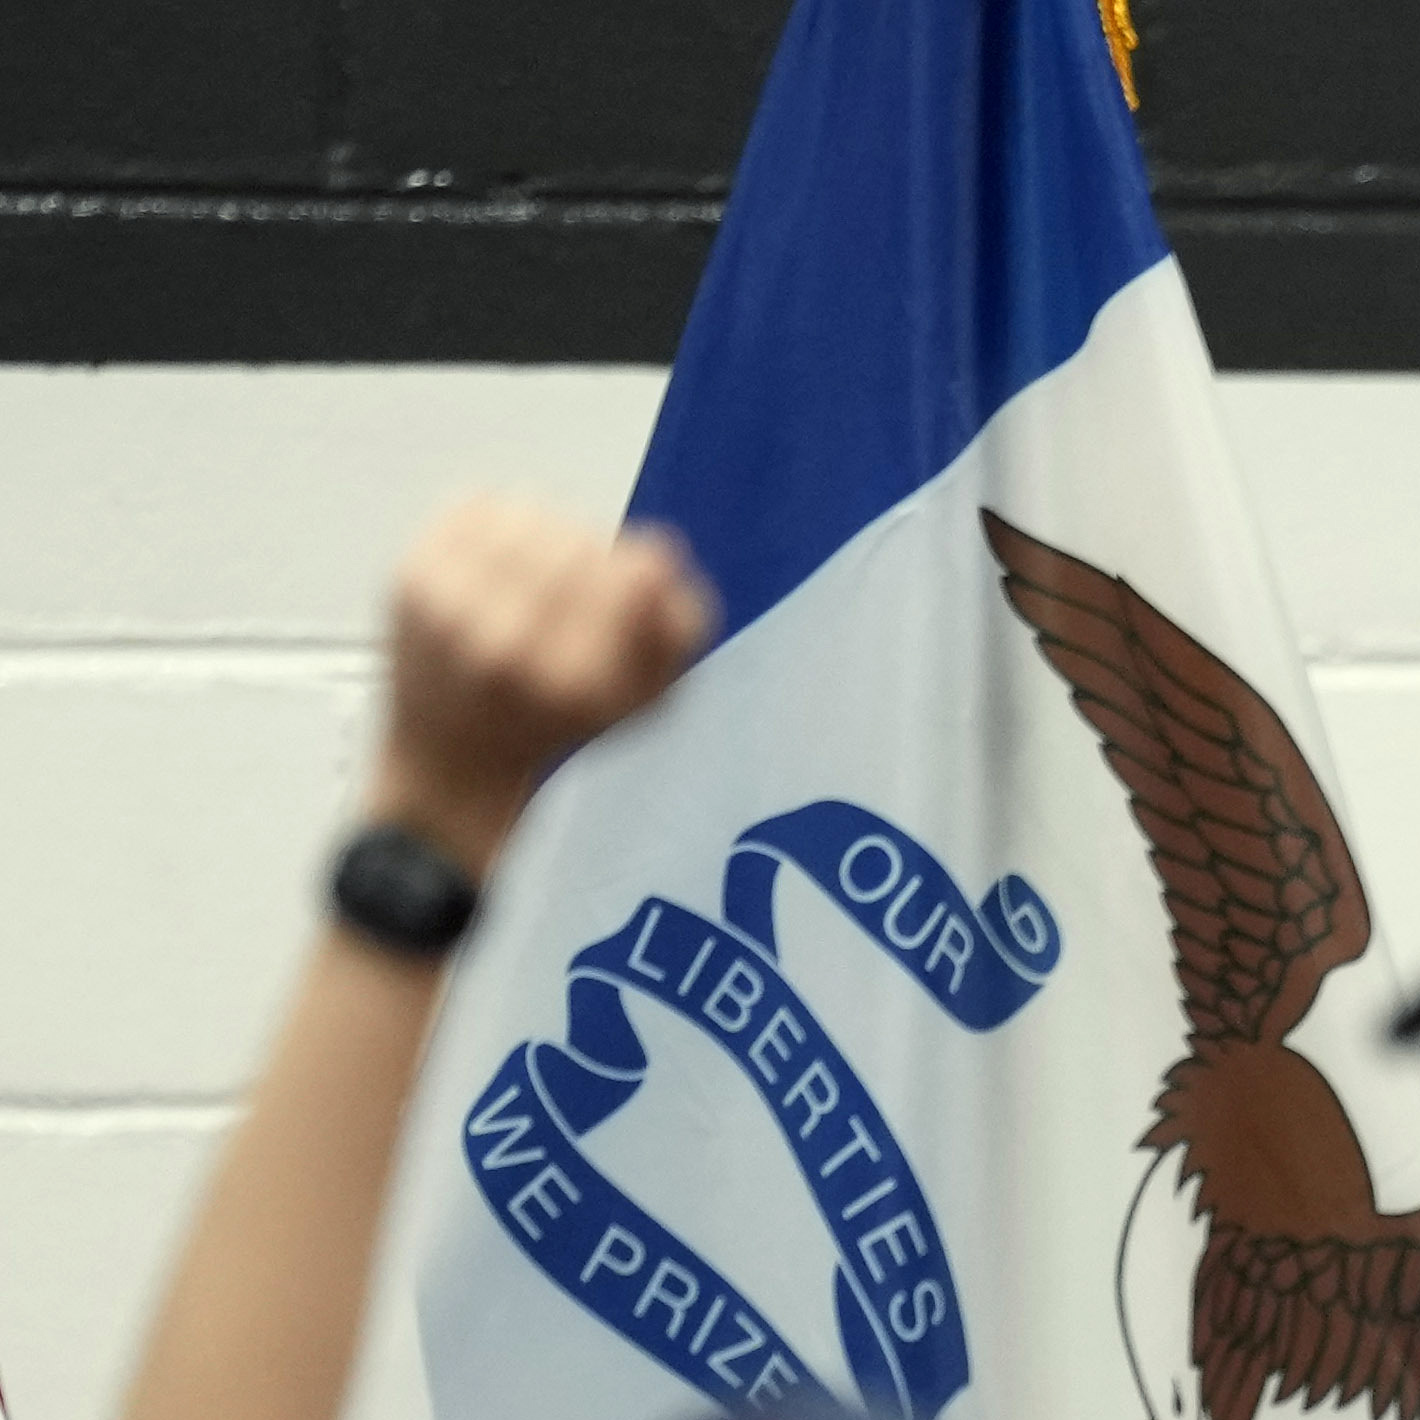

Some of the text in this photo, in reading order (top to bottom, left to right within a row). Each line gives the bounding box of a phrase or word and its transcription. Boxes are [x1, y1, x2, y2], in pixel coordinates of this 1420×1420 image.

[838, 833, 976, 995] OUR
[468, 1083, 800, 1412] WE PRIZE
[625, 905, 946, 1343] LIBERTIES
